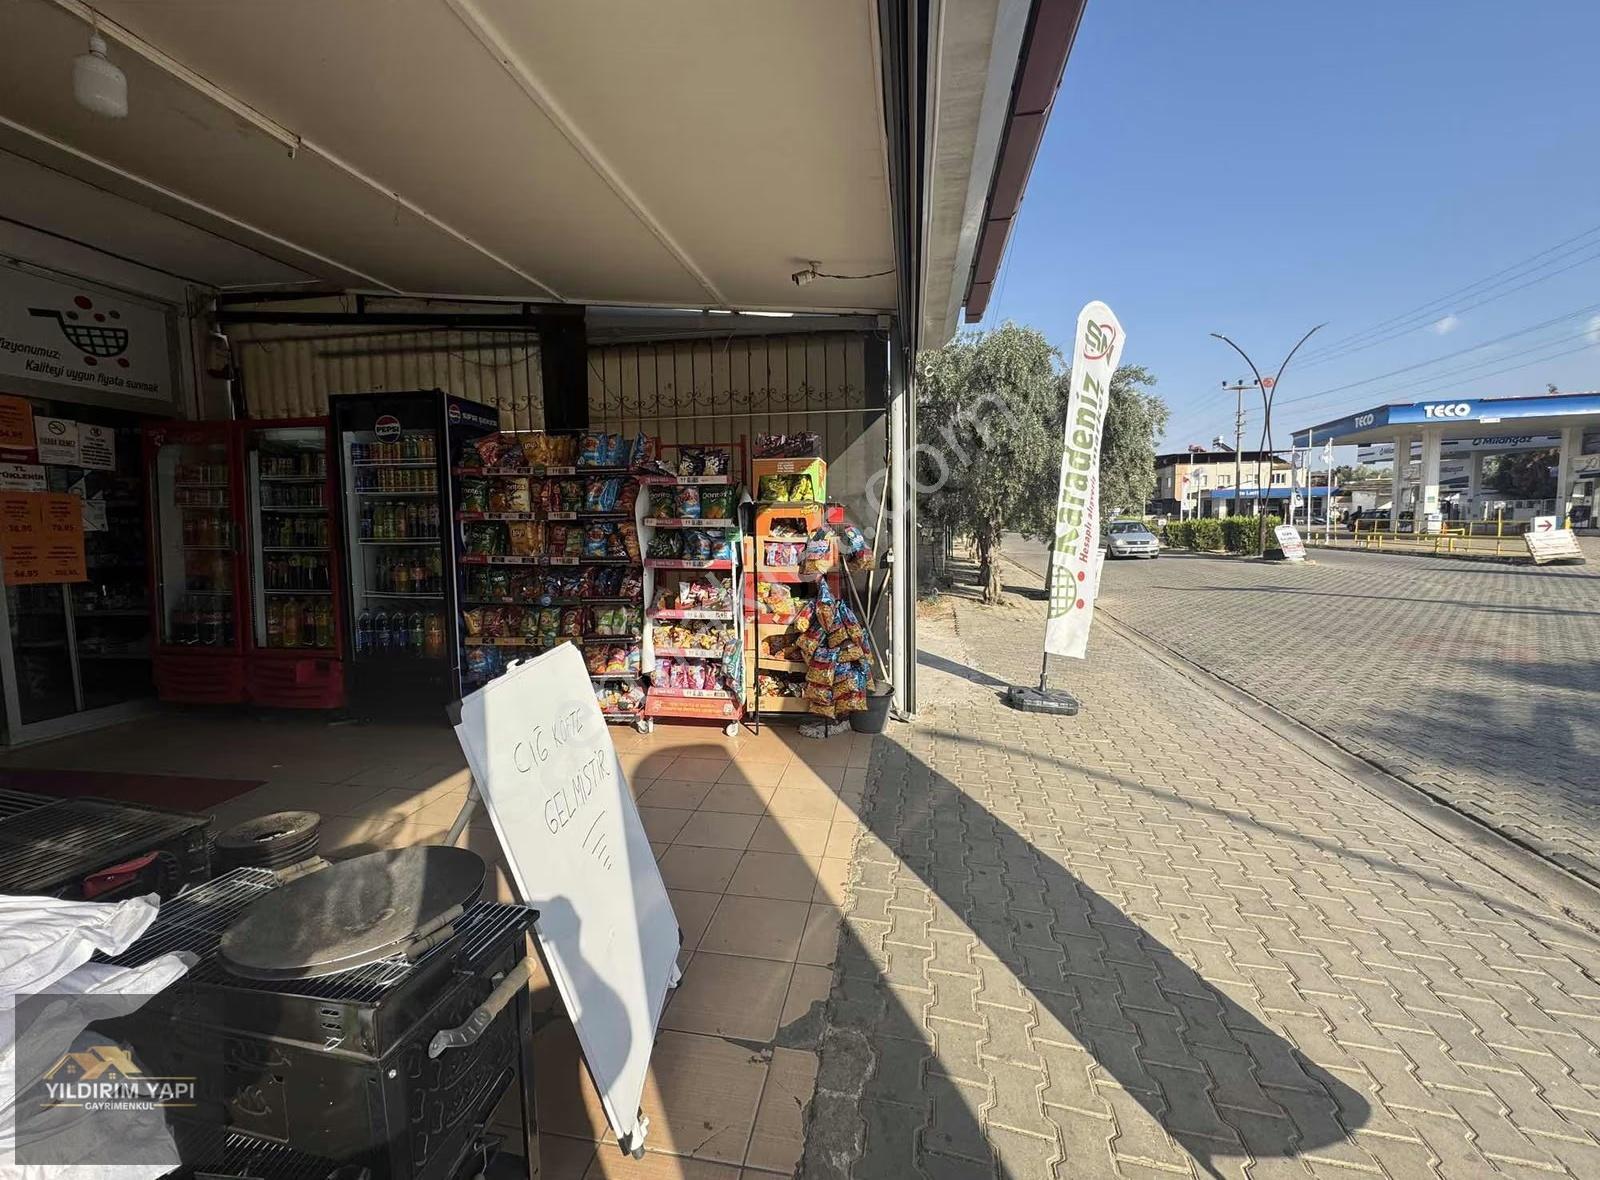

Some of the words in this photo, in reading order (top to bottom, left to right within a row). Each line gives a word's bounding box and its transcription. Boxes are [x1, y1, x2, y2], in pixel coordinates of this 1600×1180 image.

[25, 359, 64, 377] Kaliteyi
[66, 368, 95, 382] uygun
[98, 373, 124, 387] fiyata
[126, 380, 159, 393] sunmak
[1423, 403, 1471, 418] TECO
[1355, 413, 1374, 429] TECO
[376, 425, 400, 434] PEPSI
[1057, 371, 1100, 556] Karadeniz
